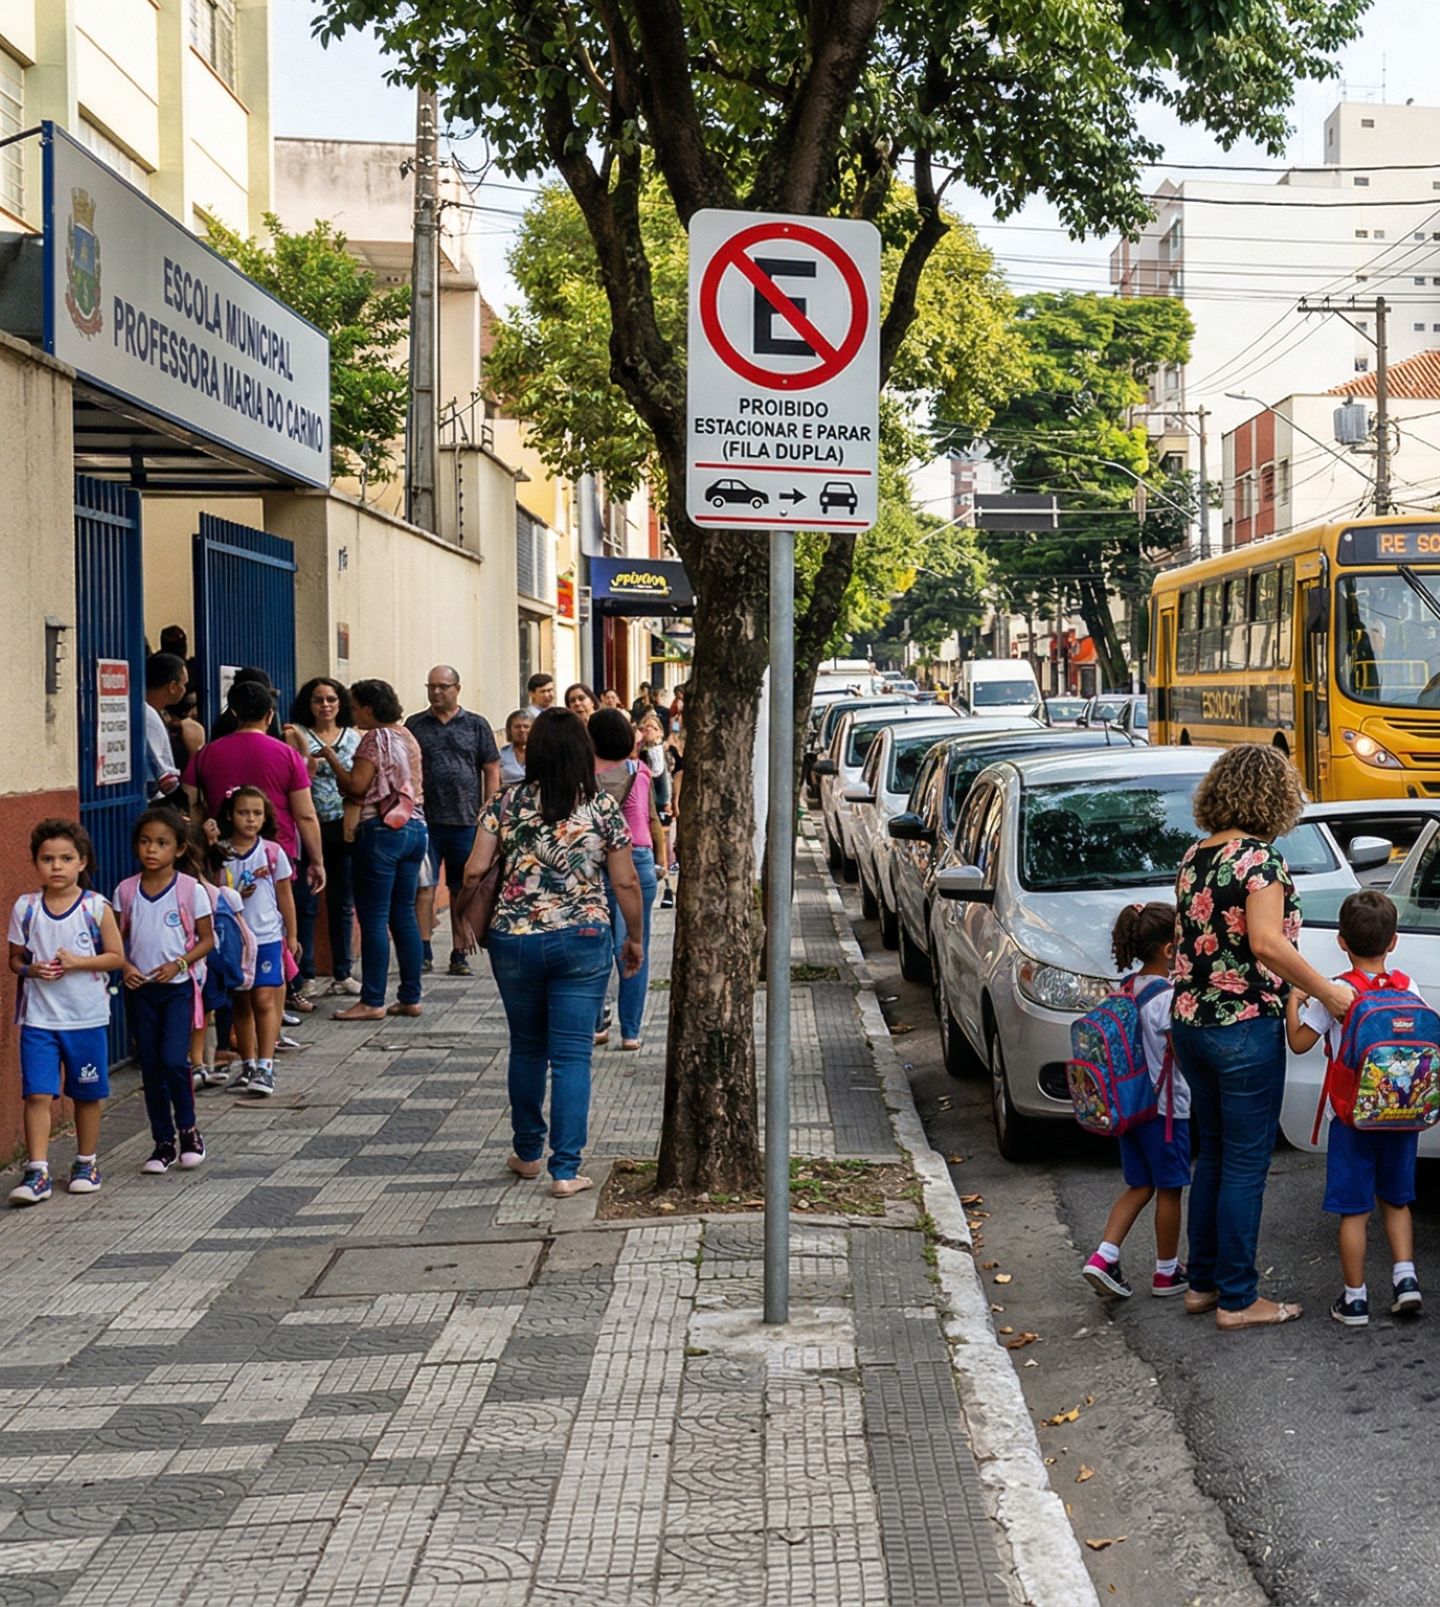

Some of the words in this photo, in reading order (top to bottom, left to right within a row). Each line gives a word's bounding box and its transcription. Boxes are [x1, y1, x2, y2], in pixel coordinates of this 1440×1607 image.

[164, 257, 223, 339] ESCOLA
[226, 299, 293, 382] MUNICIPAL
[754, 257, 817, 357] E
[113, 295, 221, 402] PROFESSORA
[223, 362, 265, 425] MARIA
[266, 387, 284, 434] DO
[286, 400, 323, 454] CARMO
[739, 398, 829, 418] PROIBIDO
[694, 418, 798, 439] ESTACIONAR
[802, 423, 813, 439] E
[817, 425, 871, 442] PARAR
[722, 440, 771, 461] (FILA
[775, 443, 844, 466] DUPLA)
[1380, 533, 1407, 553] RE
